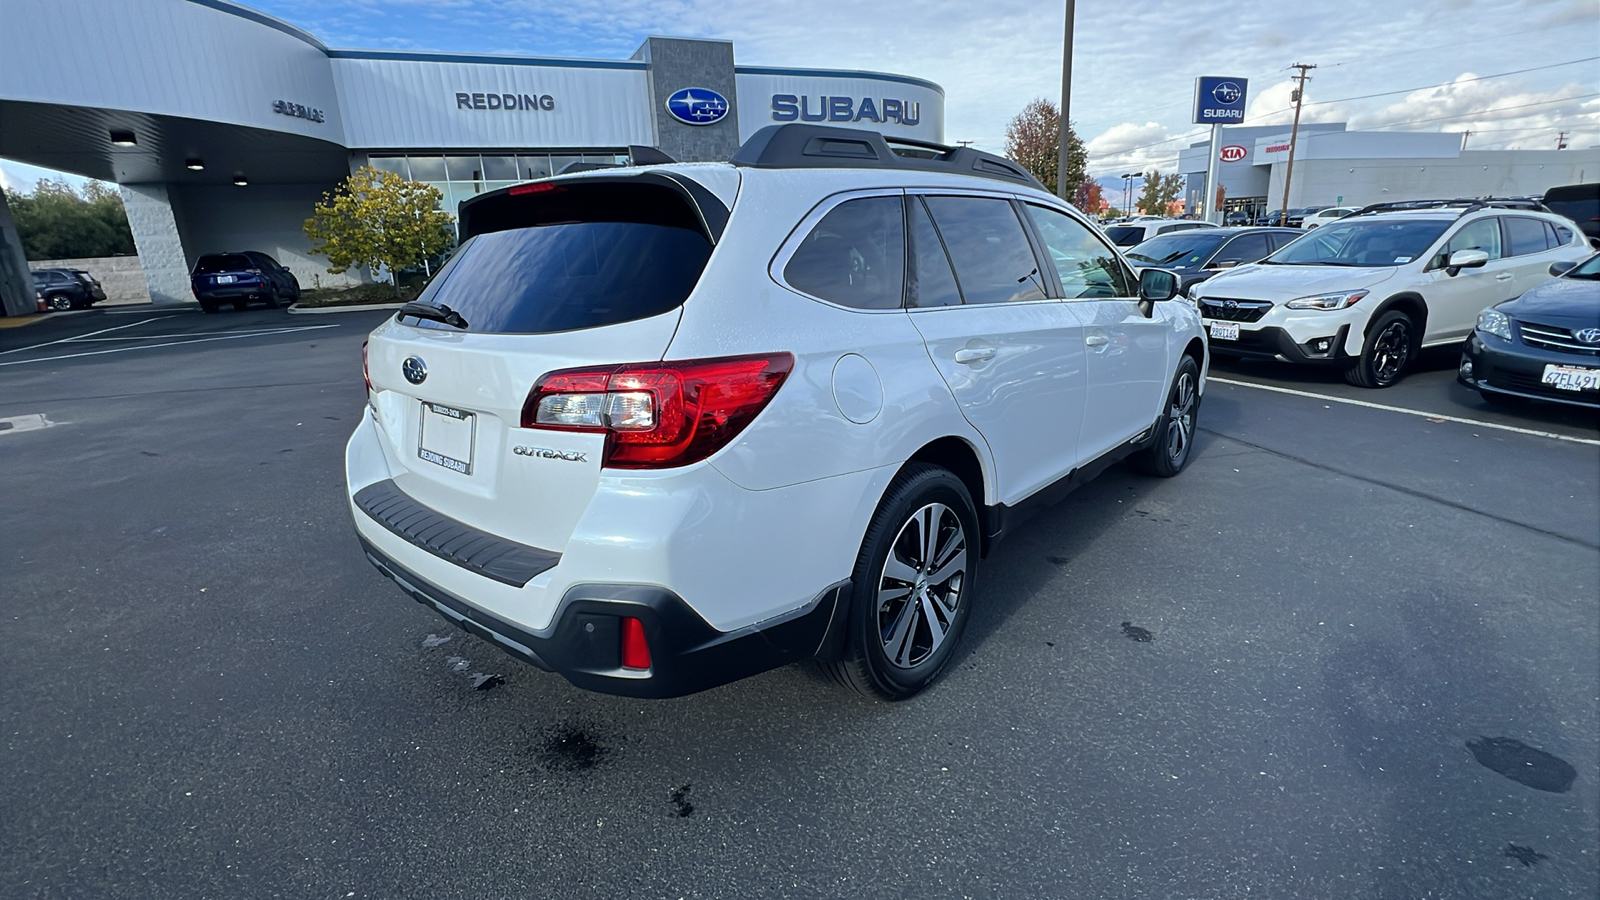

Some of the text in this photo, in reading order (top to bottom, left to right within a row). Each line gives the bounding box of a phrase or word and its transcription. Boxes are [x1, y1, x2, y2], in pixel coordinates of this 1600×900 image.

[455, 92, 555, 111] REDDING
[771, 94, 920, 126] SUBARU
[1203, 109, 1243, 119] SUBARU
[1222, 149, 1242, 159] KIA
[1266, 144, 1290, 154] REDDIN
[1545, 371, 1598, 388] 6ZFL491
[421, 449, 466, 472] REDDING SUBARU
[513, 445, 588, 463] OUTBACK
